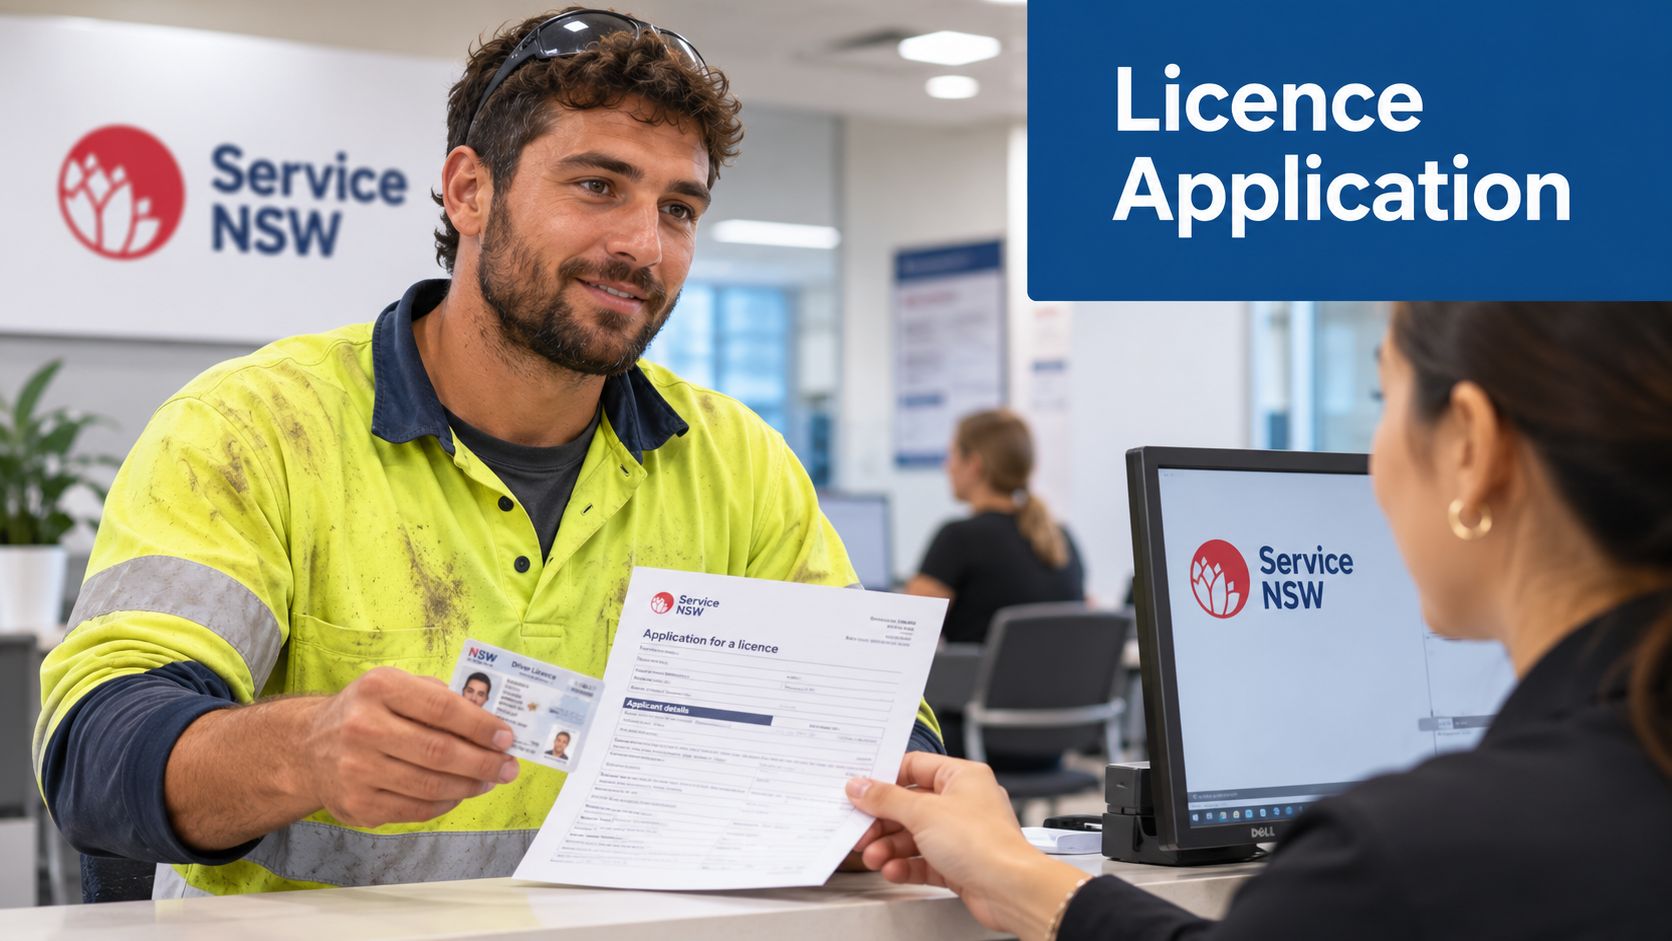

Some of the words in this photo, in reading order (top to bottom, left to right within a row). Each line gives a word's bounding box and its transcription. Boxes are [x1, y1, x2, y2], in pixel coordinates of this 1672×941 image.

[211, 144, 408, 206] Service
[211, 206, 342, 258] NSW
[1259, 545, 1354, 575] Service
[679, 594, 720, 608] Service
[1262, 581, 1324, 610] NSW
[676, 605, 704, 617] NSW
[643, 628, 707, 646] Application
[709, 636, 726, 648] for
[728, 640, 735, 649] a
[738, 639, 779, 654] licence
[468, 647, 498, 662] NSW
[511, 660, 531, 672] Driver
[626, 699, 663, 712] Applicant
[664, 704, 689, 714] details
[1251, 826, 1275, 838] DELL
